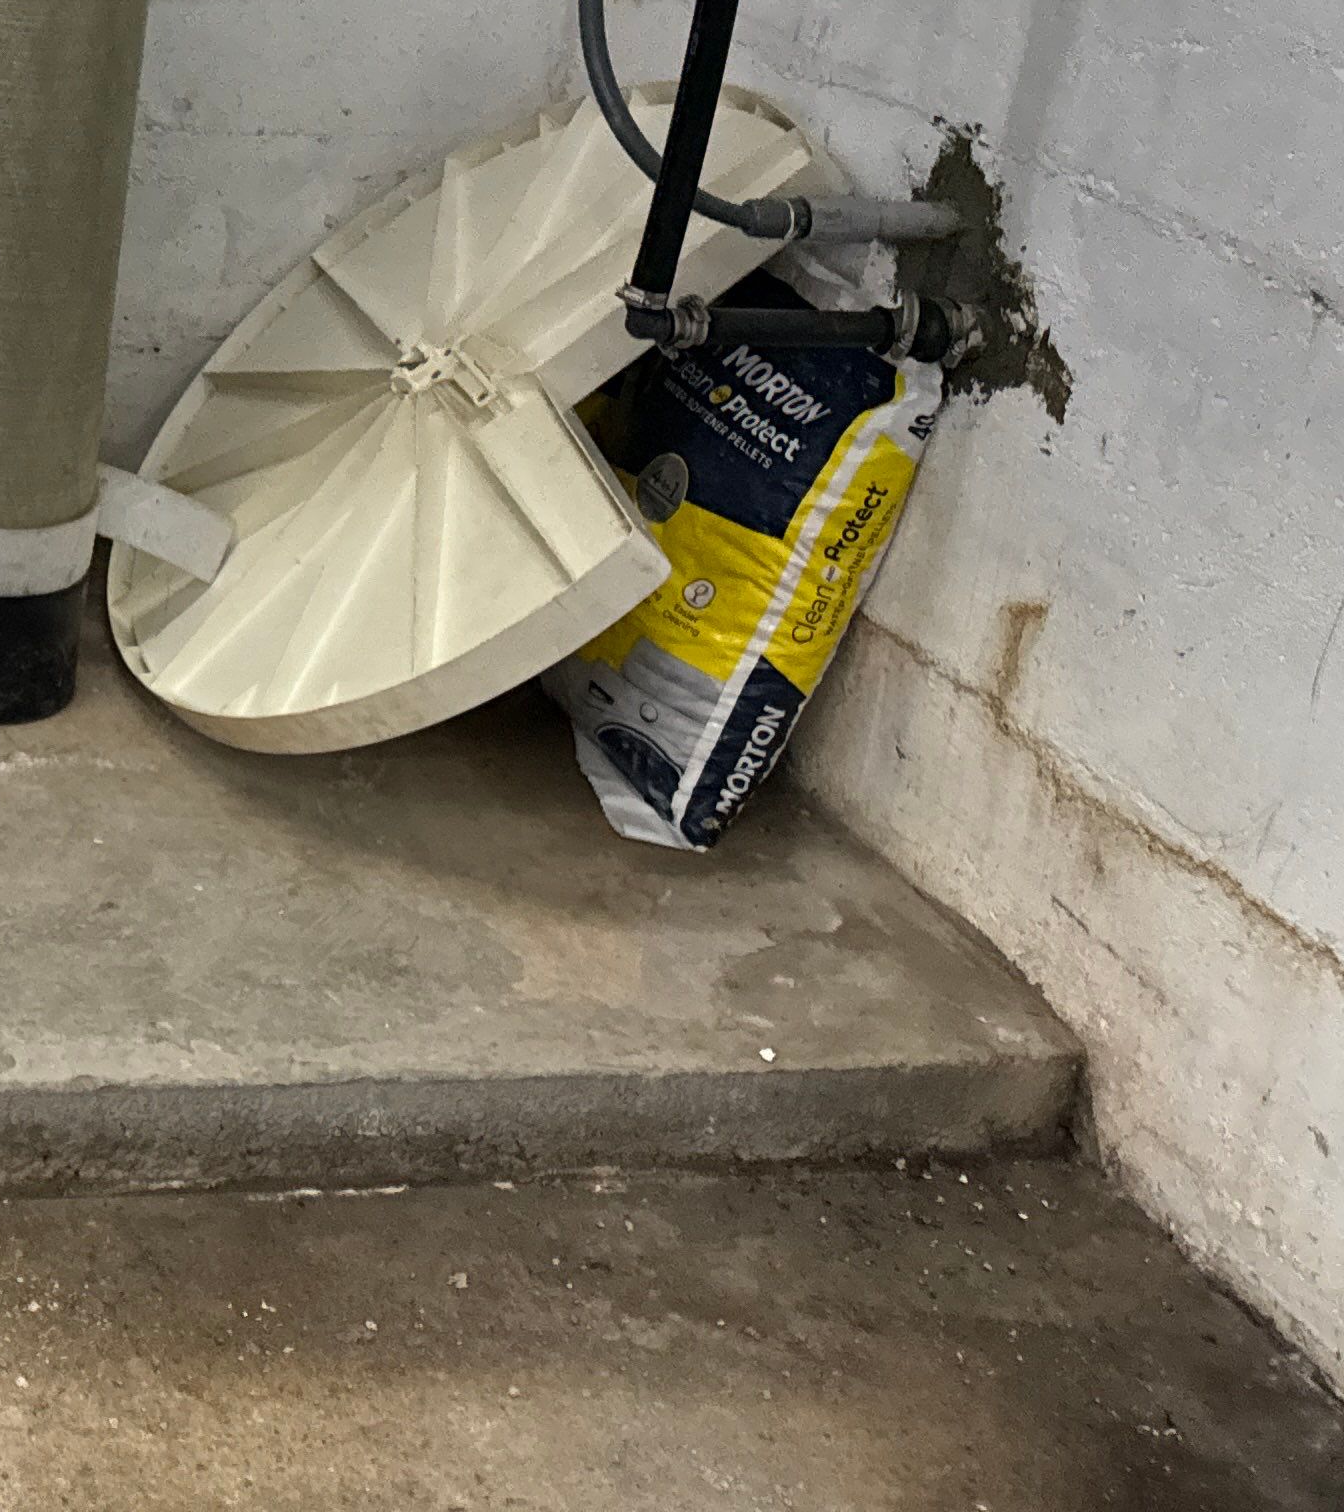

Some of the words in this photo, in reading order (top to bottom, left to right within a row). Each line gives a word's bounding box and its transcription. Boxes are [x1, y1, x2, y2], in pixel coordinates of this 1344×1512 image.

[722, 344, 832, 424] MORTON
[686, 398, 729, 436] SOFTENER
[727, 431, 773, 469] PELLETS
[720, 394, 800, 463] Protect
[792, 582, 834, 645] Clean
[824, 482, 888, 563] Protect
[715, 705, 786, 815] MORTON
